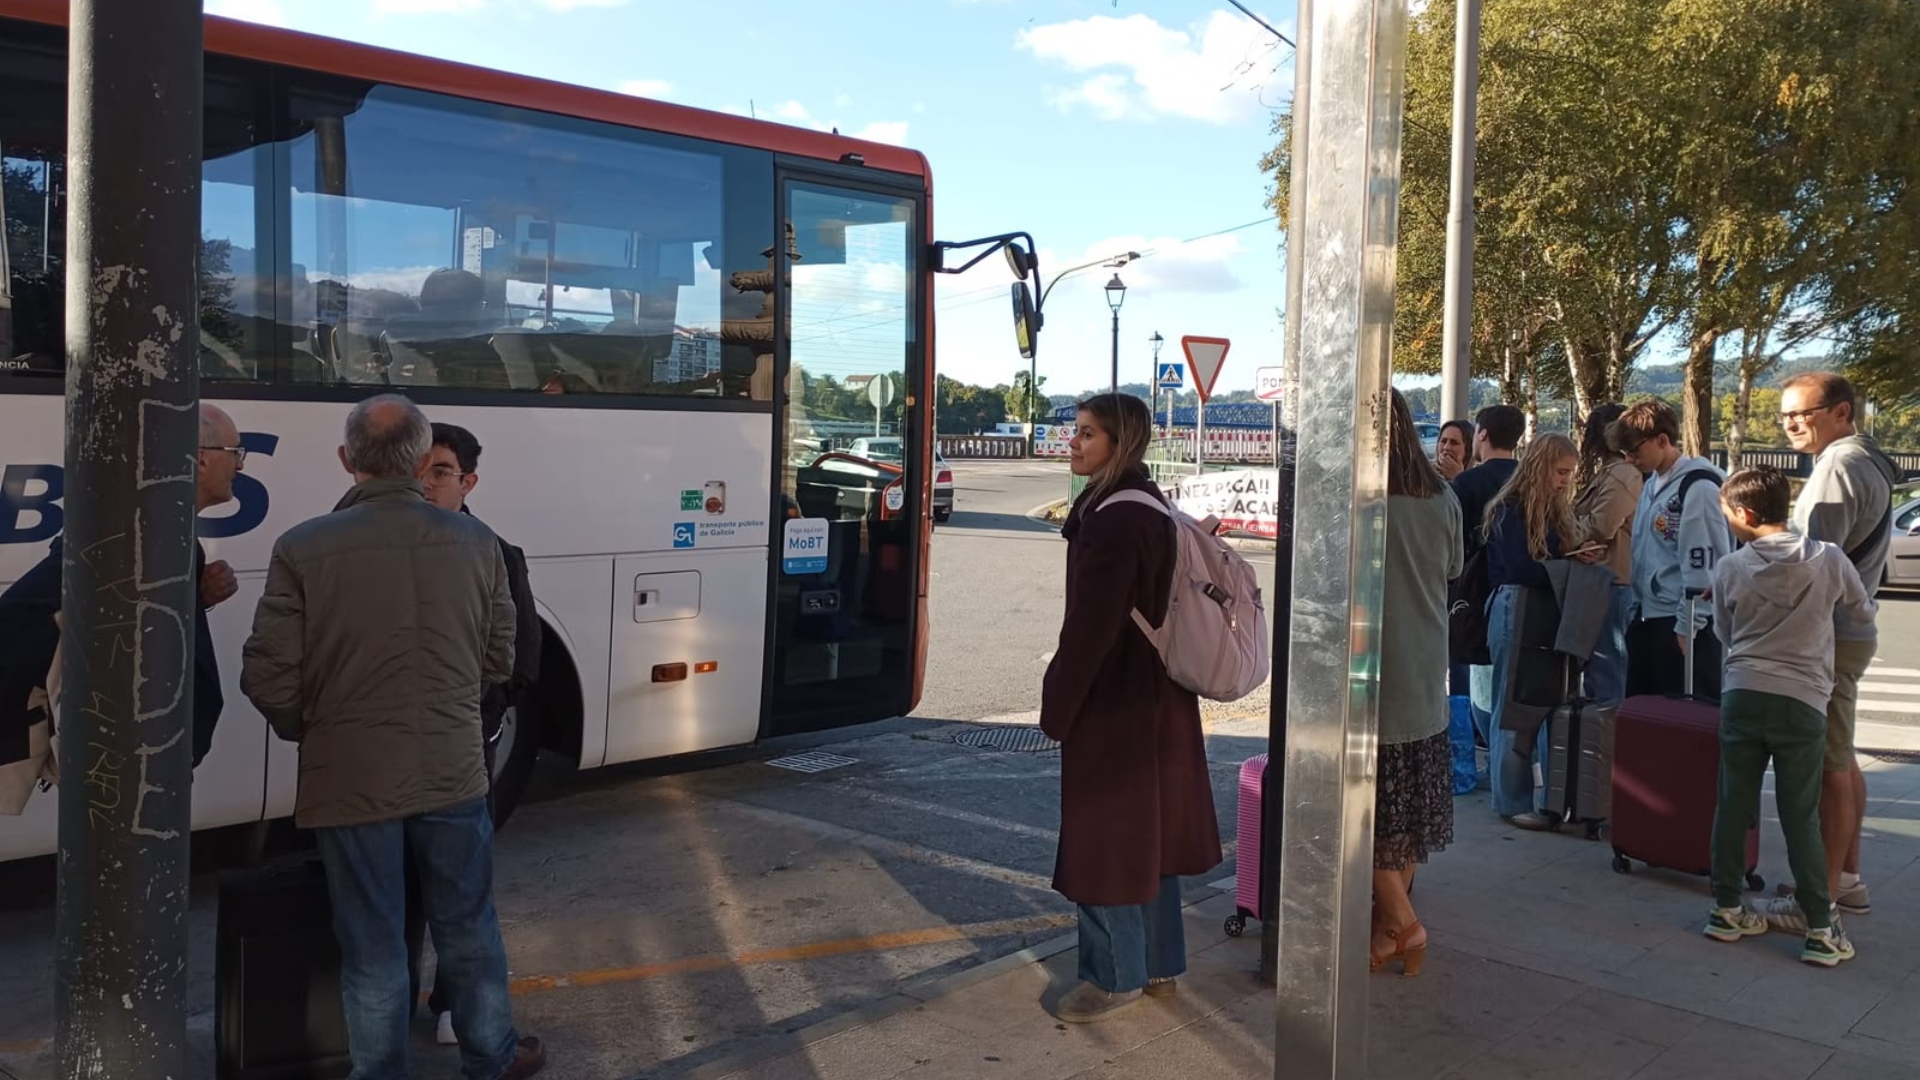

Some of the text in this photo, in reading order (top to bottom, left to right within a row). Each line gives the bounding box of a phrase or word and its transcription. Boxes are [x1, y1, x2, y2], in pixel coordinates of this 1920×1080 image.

[0, 432, 279, 544] BS
[700, 521, 736, 530] transporte
[789, 536, 824, 549] MoBT
[1689, 546, 1714, 569] 91
